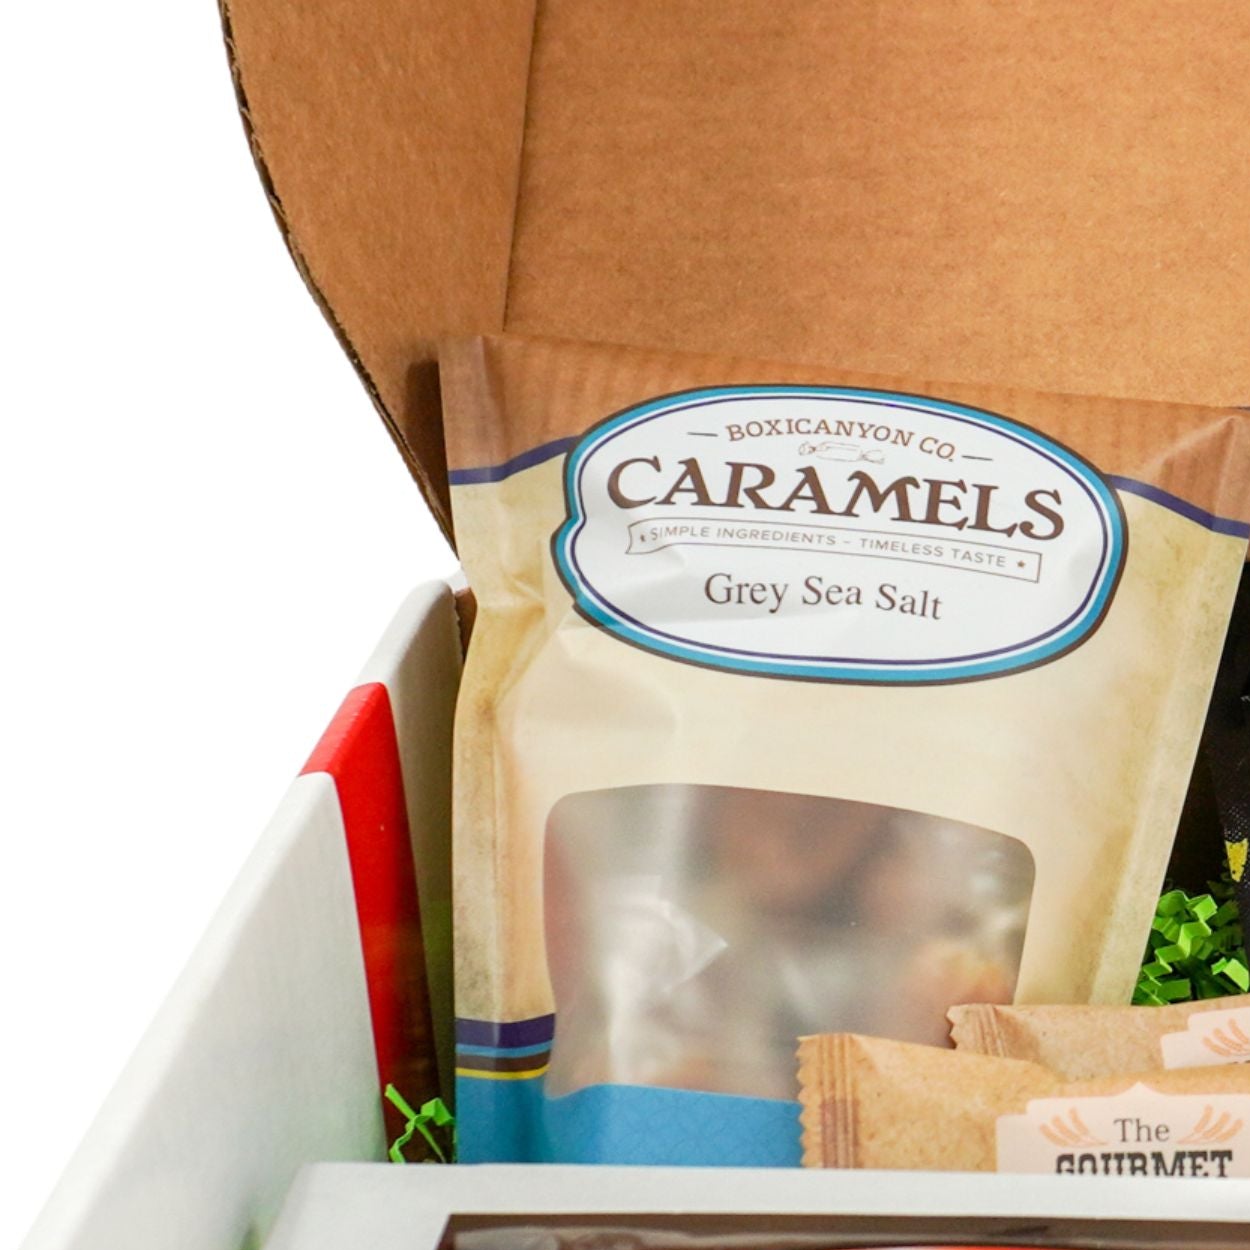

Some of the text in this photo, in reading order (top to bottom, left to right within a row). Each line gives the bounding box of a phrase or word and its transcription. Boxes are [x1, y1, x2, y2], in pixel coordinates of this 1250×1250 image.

[726, 417, 957, 463] BOXICANYON CO.
[606, 455, 1066, 543] CARAMELS
[649, 526, 710, 541] SIMPLE
[717, 528, 837, 547] INGREDIENTS
[859, 537, 944, 558] TIMELESS
[951, 549, 1007, 568] TASTE
[704, 572, 943, 621] Grey Sea Salt
[1113, 1117, 1170, 1143] The
[1056, 1149, 1232, 1178] GOURMET
